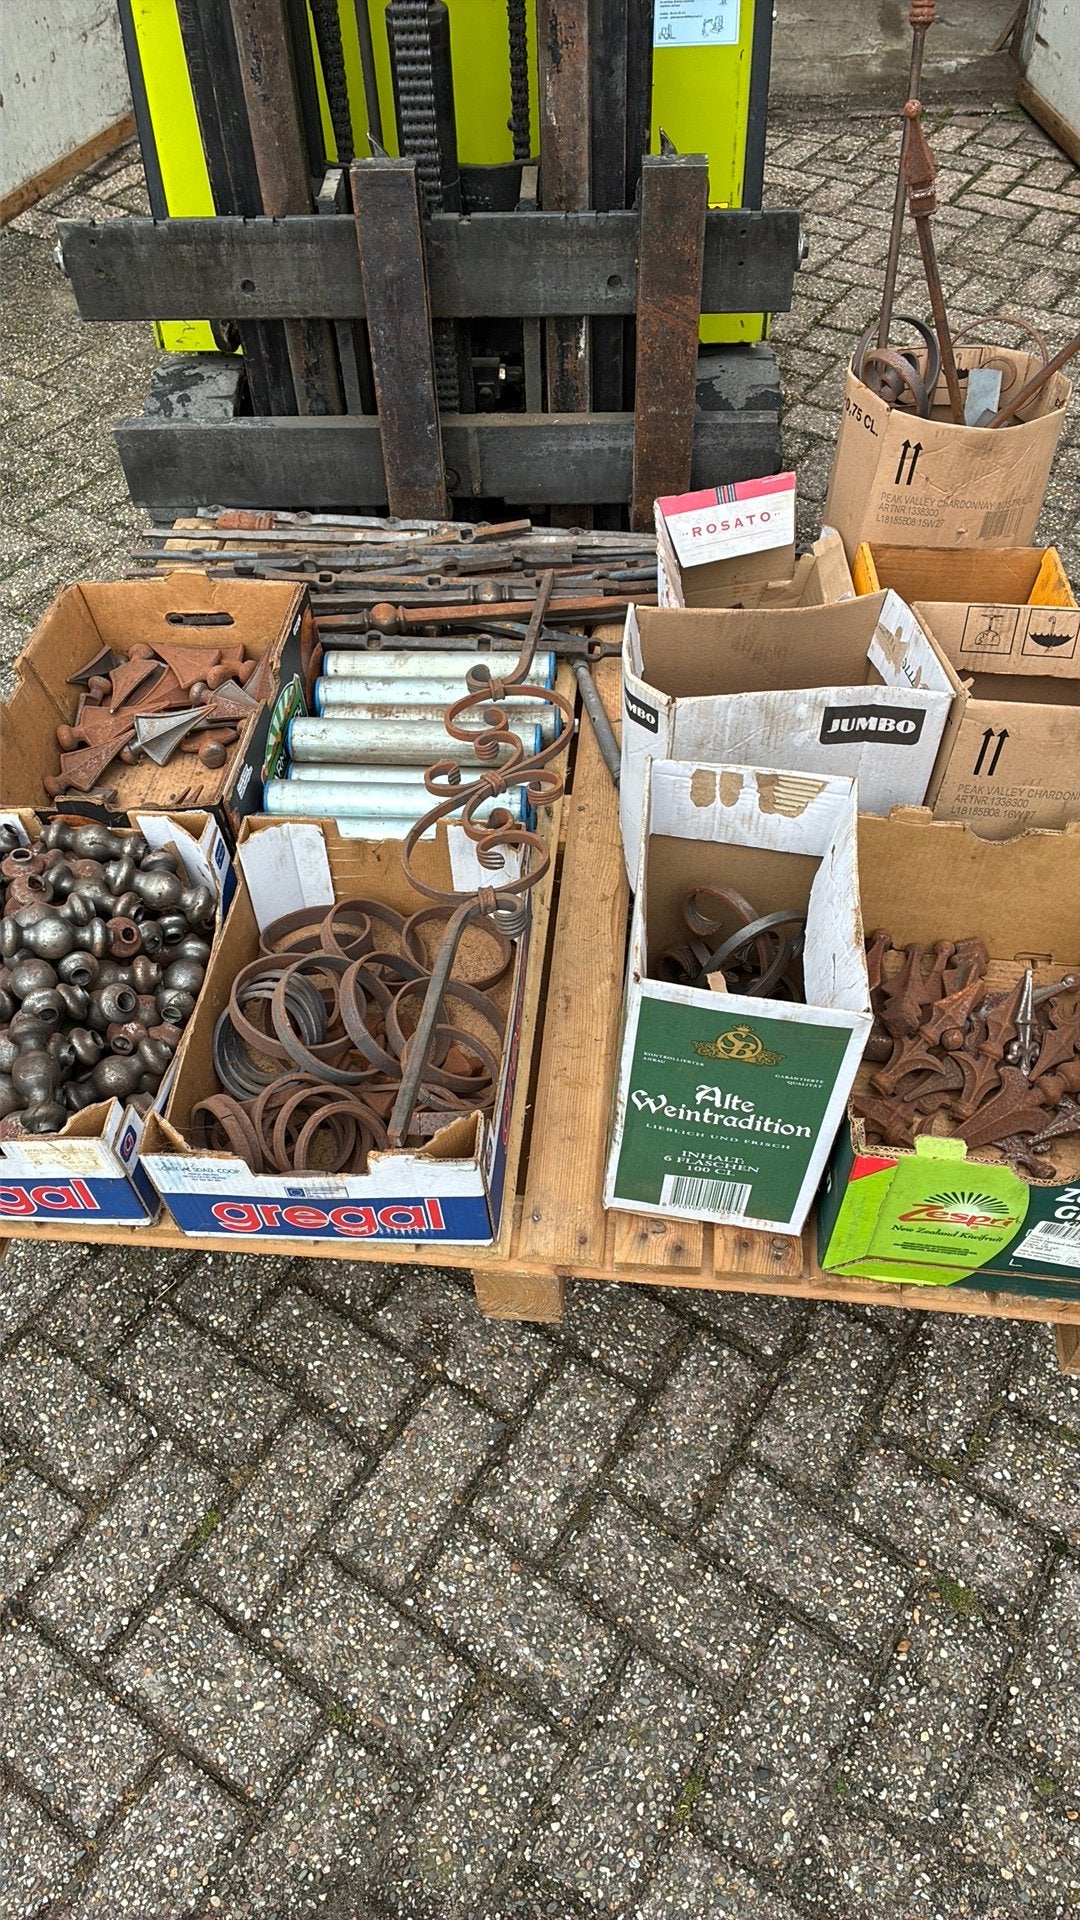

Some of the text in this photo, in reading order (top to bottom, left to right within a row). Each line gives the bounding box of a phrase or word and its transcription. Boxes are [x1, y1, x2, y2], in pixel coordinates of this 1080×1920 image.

[880, 492, 903, 504] PEAK
[904, 495, 936, 507] VALLEY
[937, 498, 996, 511] CHARDONNAY
[691, 511, 771, 538] ROSATO
[827, 716, 916, 736] JUMBO
[957, 784, 985, 795] PEAK
[987, 786, 1026, 797] VALLEY
[774, 1074, 825, 1084] GARANTIERTE
[694, 1084, 755, 1113] Alte
[630, 1089, 813, 1139] Weintradition
[645, 1123, 791, 1150] LIEBLICH UND FRISCH
[663, 1154, 760, 1174] 6 FLASCHEN
[686, 1165, 736, 1177] 100 CL
[211, 1198, 447, 1237] gregal
[897, 1203, 1015, 1229] Zespri
[891, 1224, 1004, 1243] New Zealand Kiwifruit
